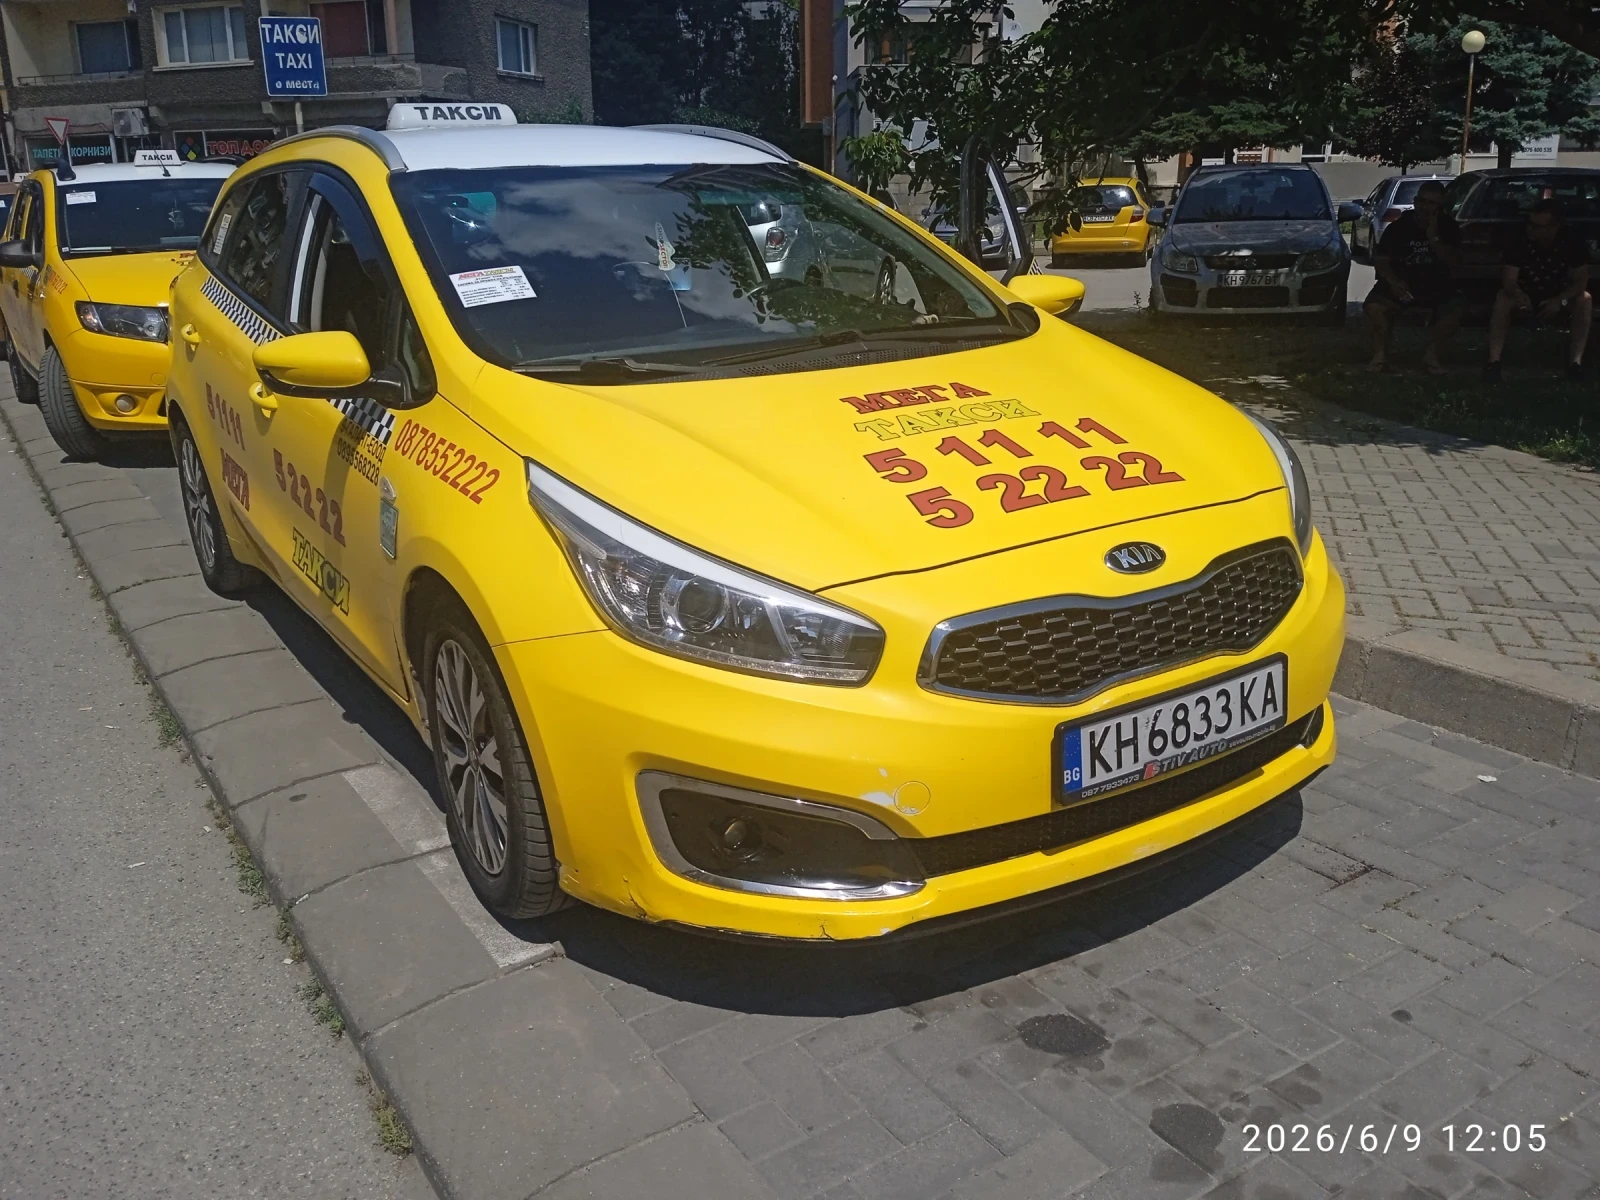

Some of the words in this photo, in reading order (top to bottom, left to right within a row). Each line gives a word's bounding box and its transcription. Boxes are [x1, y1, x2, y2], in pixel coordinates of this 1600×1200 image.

[261, 23, 320, 44] ТАКСИ
[275, 52, 313, 69] TAXI
[413, 106, 502, 120] ТАКСИ
[70, 145, 112, 157] КОРНИЗИ
[206, 140, 240, 155] ТОП
[839, 382, 992, 414] МЕГА
[853, 398, 1042, 442] ТАКСИ
[394, 418, 500, 505] 0878552222
[220, 447, 250, 512] МЕГА
[1112, 544, 1162, 569] KIA
[292, 526, 350, 616] ТАКСИ
[1188, 739, 1229, 763] AUTO
[1063, 767, 1081, 785] BG
